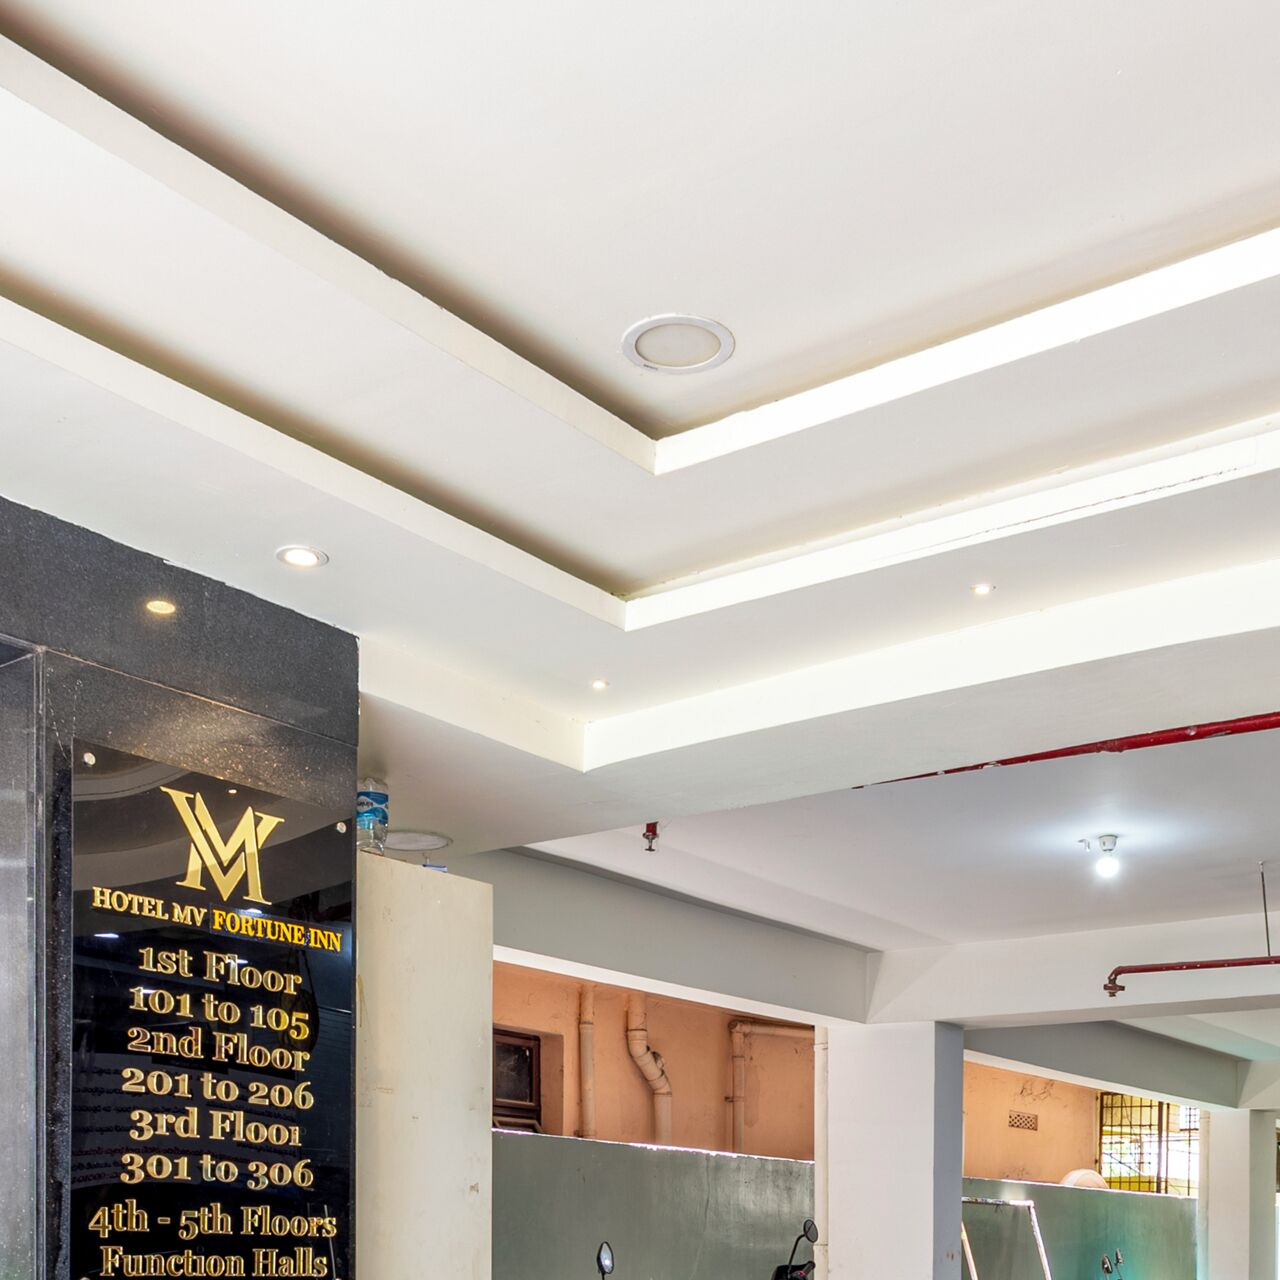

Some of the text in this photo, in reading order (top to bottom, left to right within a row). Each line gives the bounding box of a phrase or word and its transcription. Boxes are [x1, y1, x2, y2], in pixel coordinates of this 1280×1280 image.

[92, 886, 342, 953] HOTEL MV FORTUNE INN
[138, 946, 303, 996] 1st Floor
[128, 986, 310, 1041] 101 to 105
[127, 1026, 311, 1073] 2nd Floor
[121, 1067, 315, 1111] 201 to 206
[129, 1106, 200, 1141] 3rd
[120, 1152, 192, 1185] 301
[200, 1153, 239, 1183] to
[247, 1158, 315, 1191] 306
[88, 1198, 150, 1238] 4th
[178, 1202, 233, 1241] 5th
[240, 1205, 337, 1238] Floors
[99, 1245, 328, 1279] Function Halls
